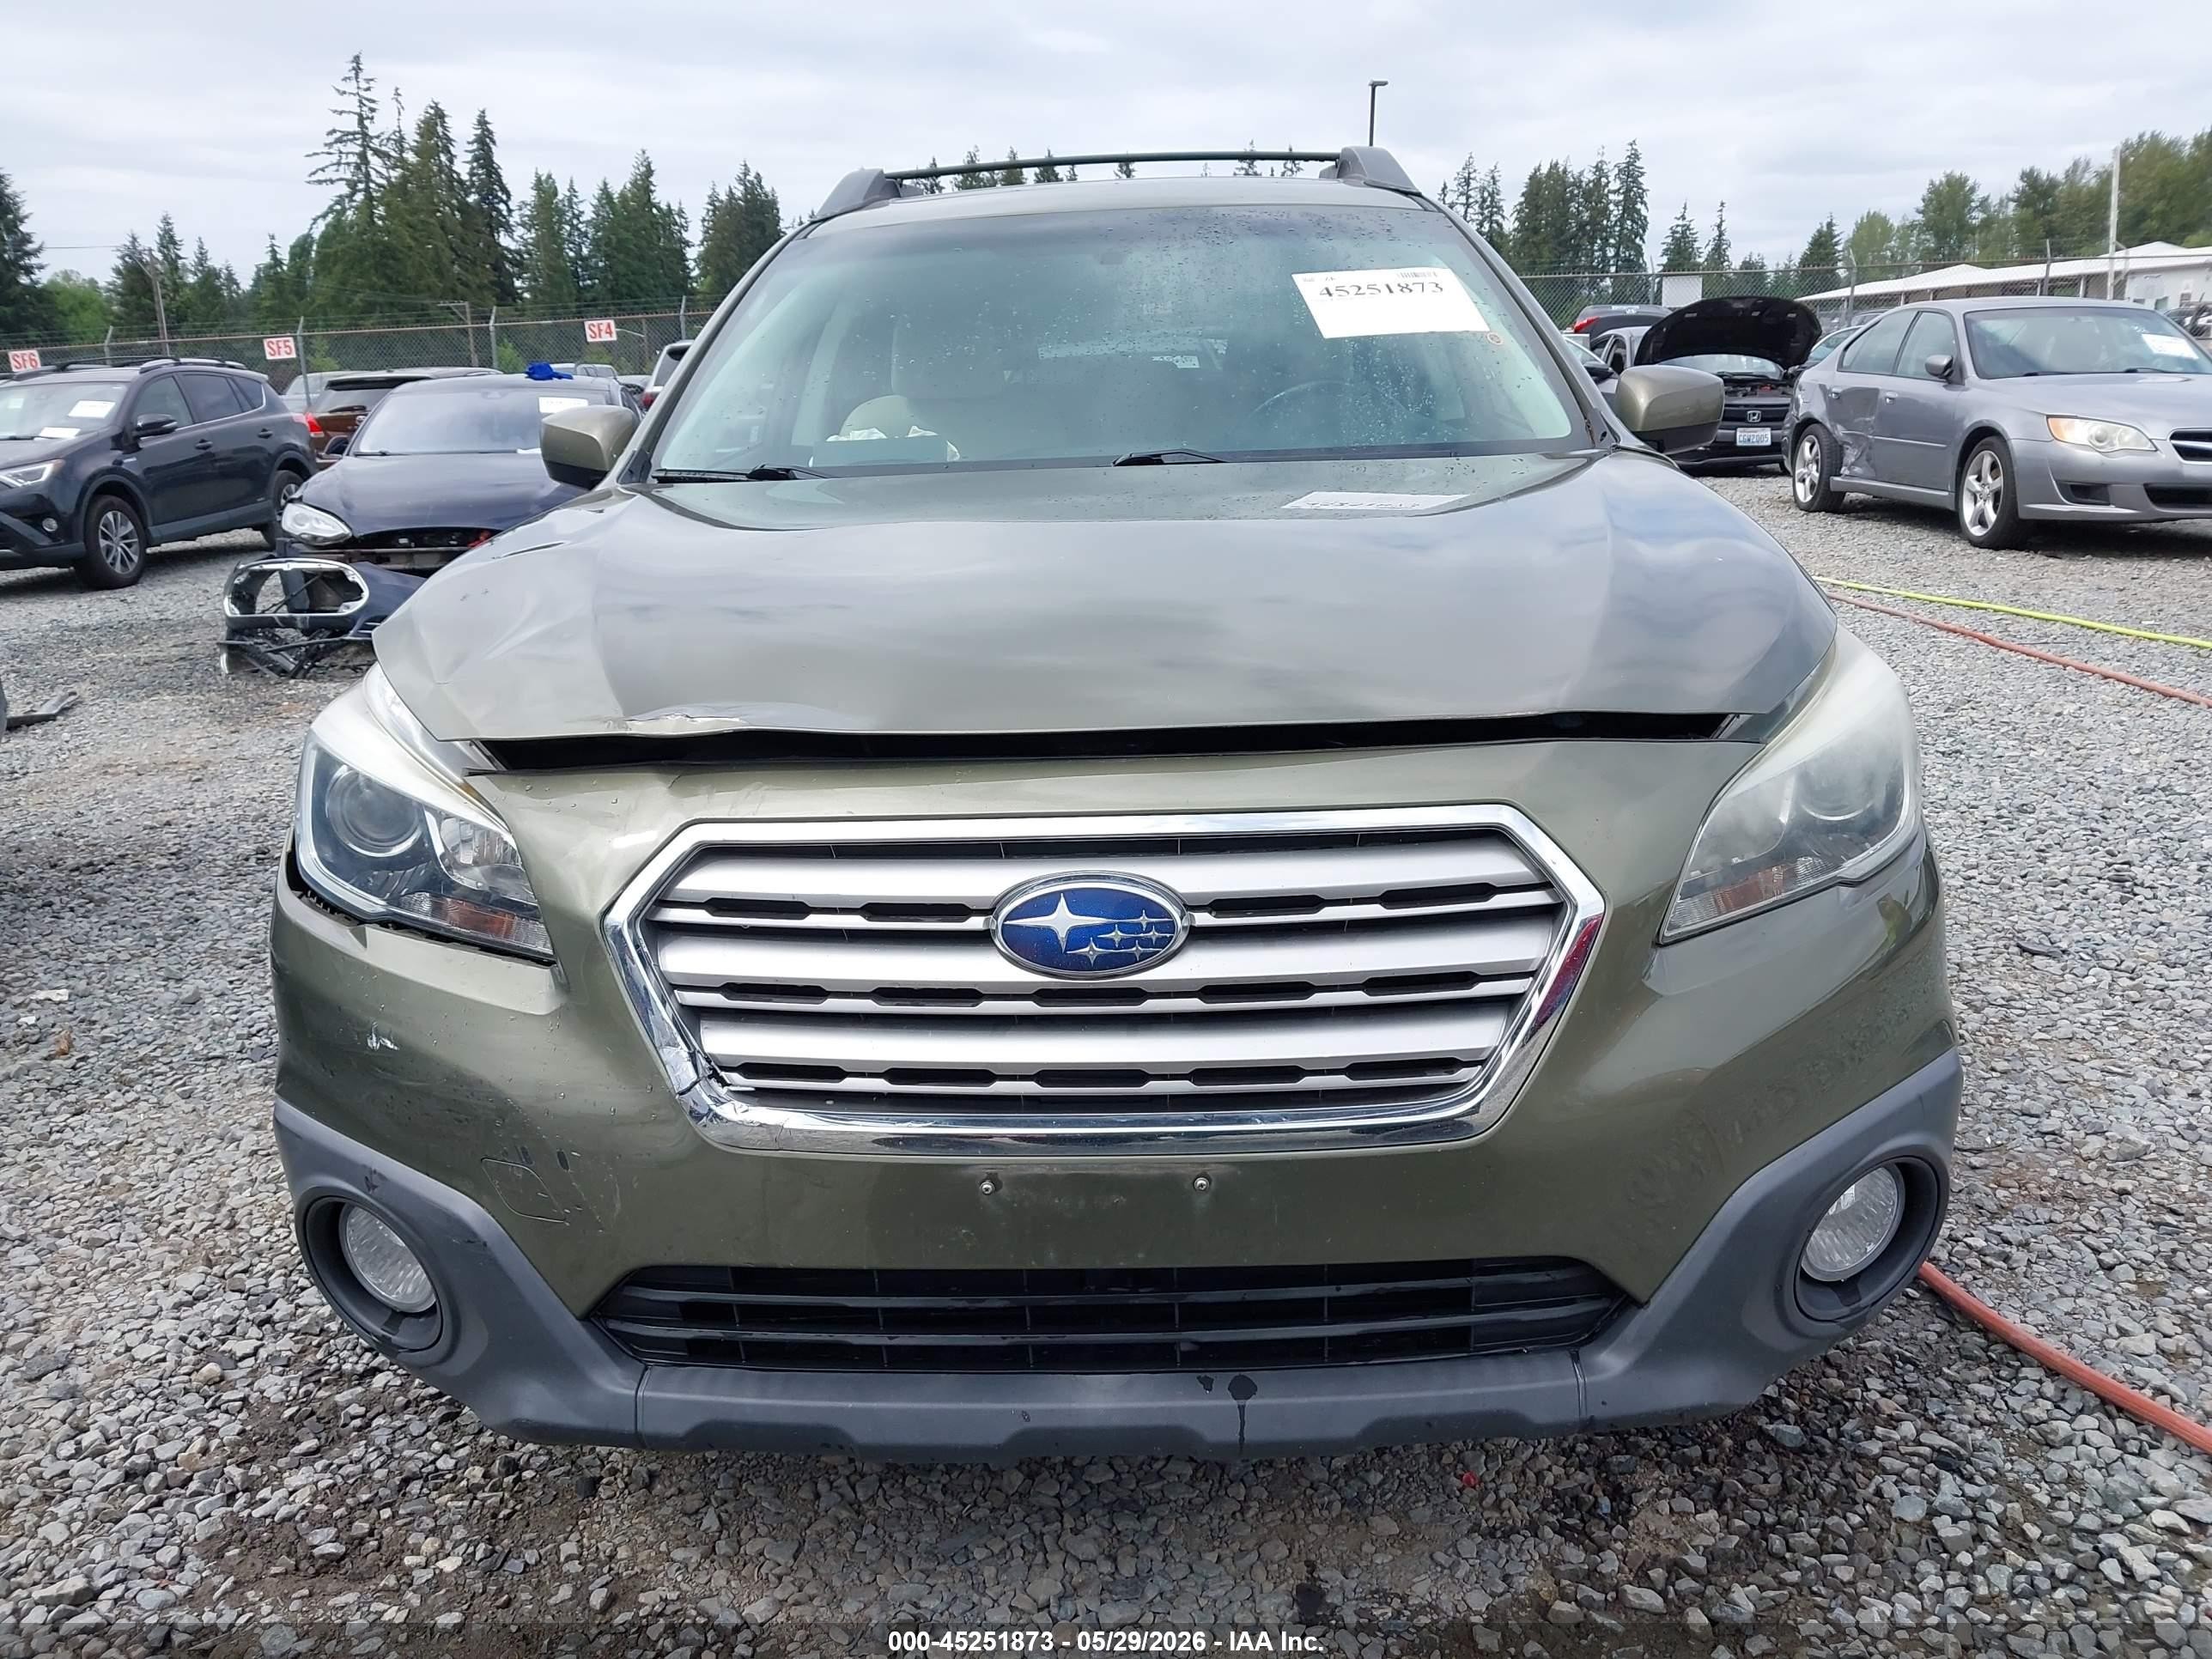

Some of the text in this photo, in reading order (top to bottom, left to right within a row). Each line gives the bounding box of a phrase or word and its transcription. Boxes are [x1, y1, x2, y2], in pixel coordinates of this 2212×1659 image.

[1319, 281, 1444, 297] 45251873
[587, 322, 613, 339] SF4
[266, 339, 293, 356] SF5
[11, 352, 39, 369] SF6
